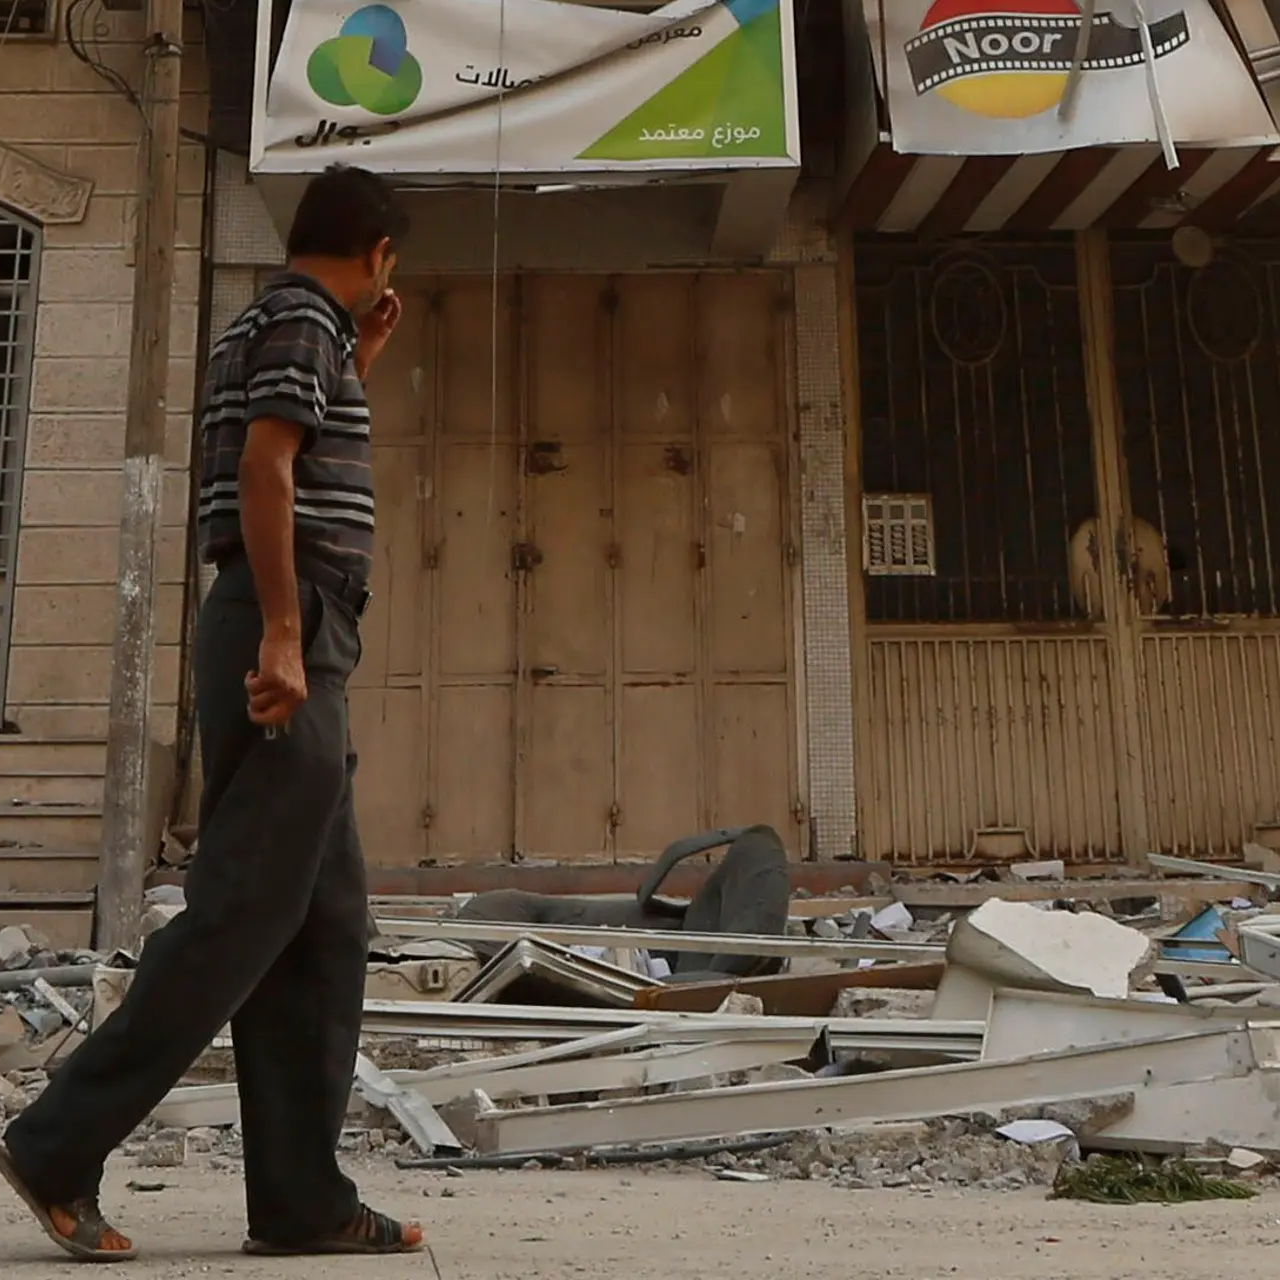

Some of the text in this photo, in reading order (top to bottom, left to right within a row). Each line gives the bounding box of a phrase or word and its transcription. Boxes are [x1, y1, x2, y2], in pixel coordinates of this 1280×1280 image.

[942, 30, 1063, 65] Noor
[638, 122, 761, 148] موزع معتمد
